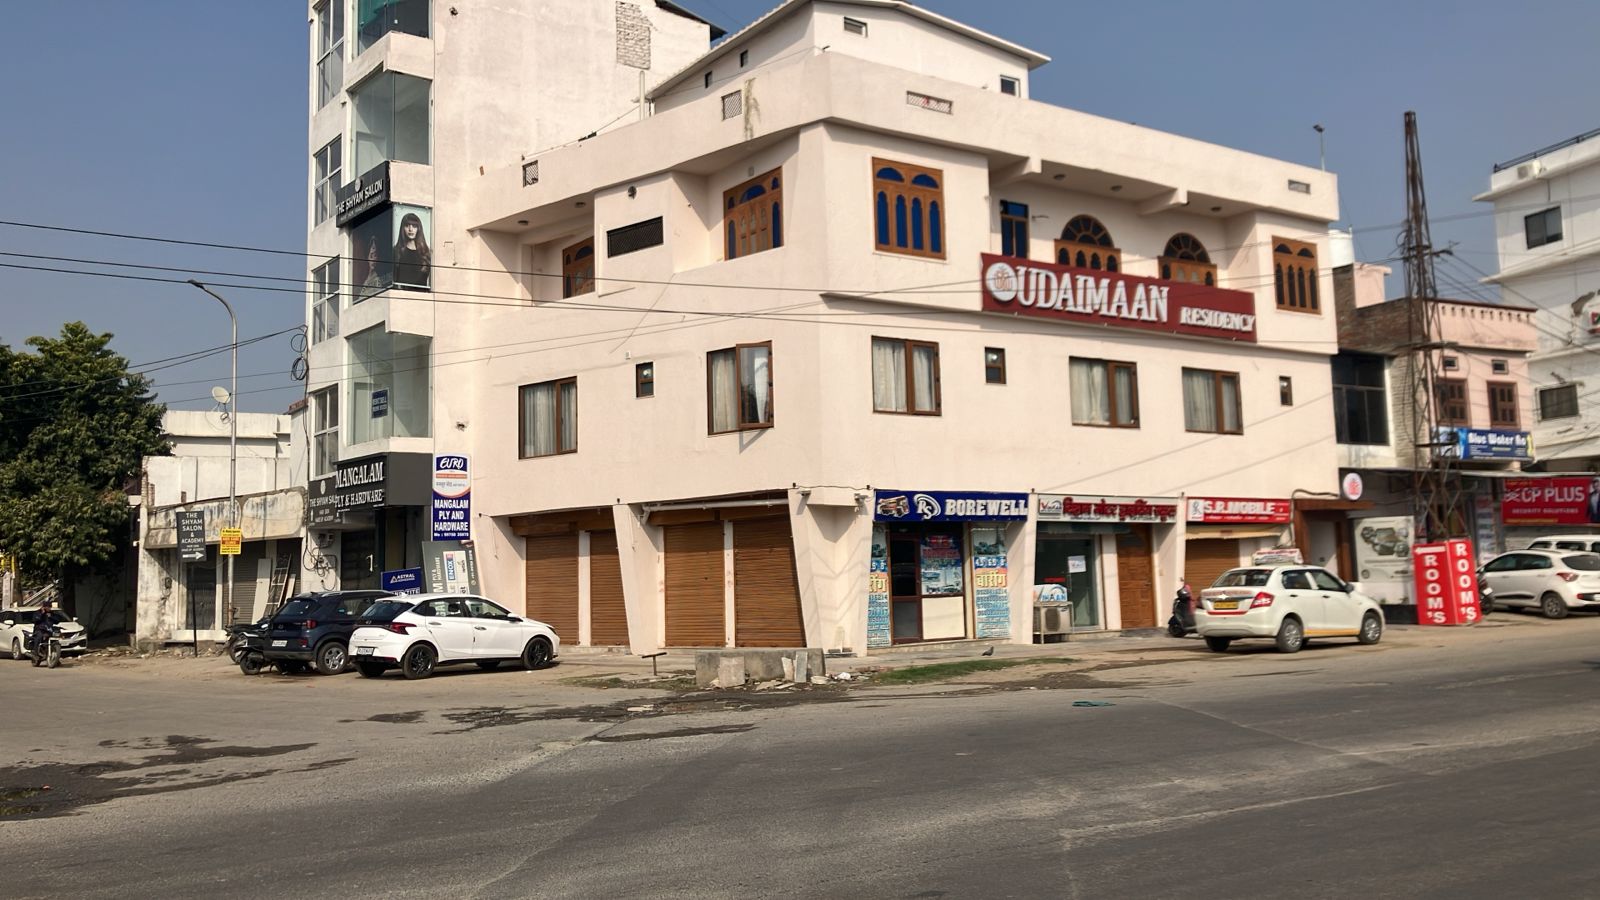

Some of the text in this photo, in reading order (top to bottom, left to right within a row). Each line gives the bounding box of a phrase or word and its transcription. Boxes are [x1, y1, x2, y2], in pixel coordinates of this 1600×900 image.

[336, 201, 344, 214] THE
[346, 191, 363, 210] SHYAM
[365, 179, 383, 199] SALON
[1015, 266, 1256, 332] UDAIMAAN RESIDENCY
[440, 457, 464, 469] EURO
[335, 462, 384, 488] MANGALAM
[335, 489, 383, 508] PLY & HARDWARE
[1521, 486, 1585, 503] CP PLUS
[434, 499, 469, 509] MANGALAM
[945, 498, 1028, 516] BOREWELL
[1228, 502, 1275, 514] MOBILE
[439, 511, 464, 520] PLY AND
[434, 522, 469, 531] HARDWARE
